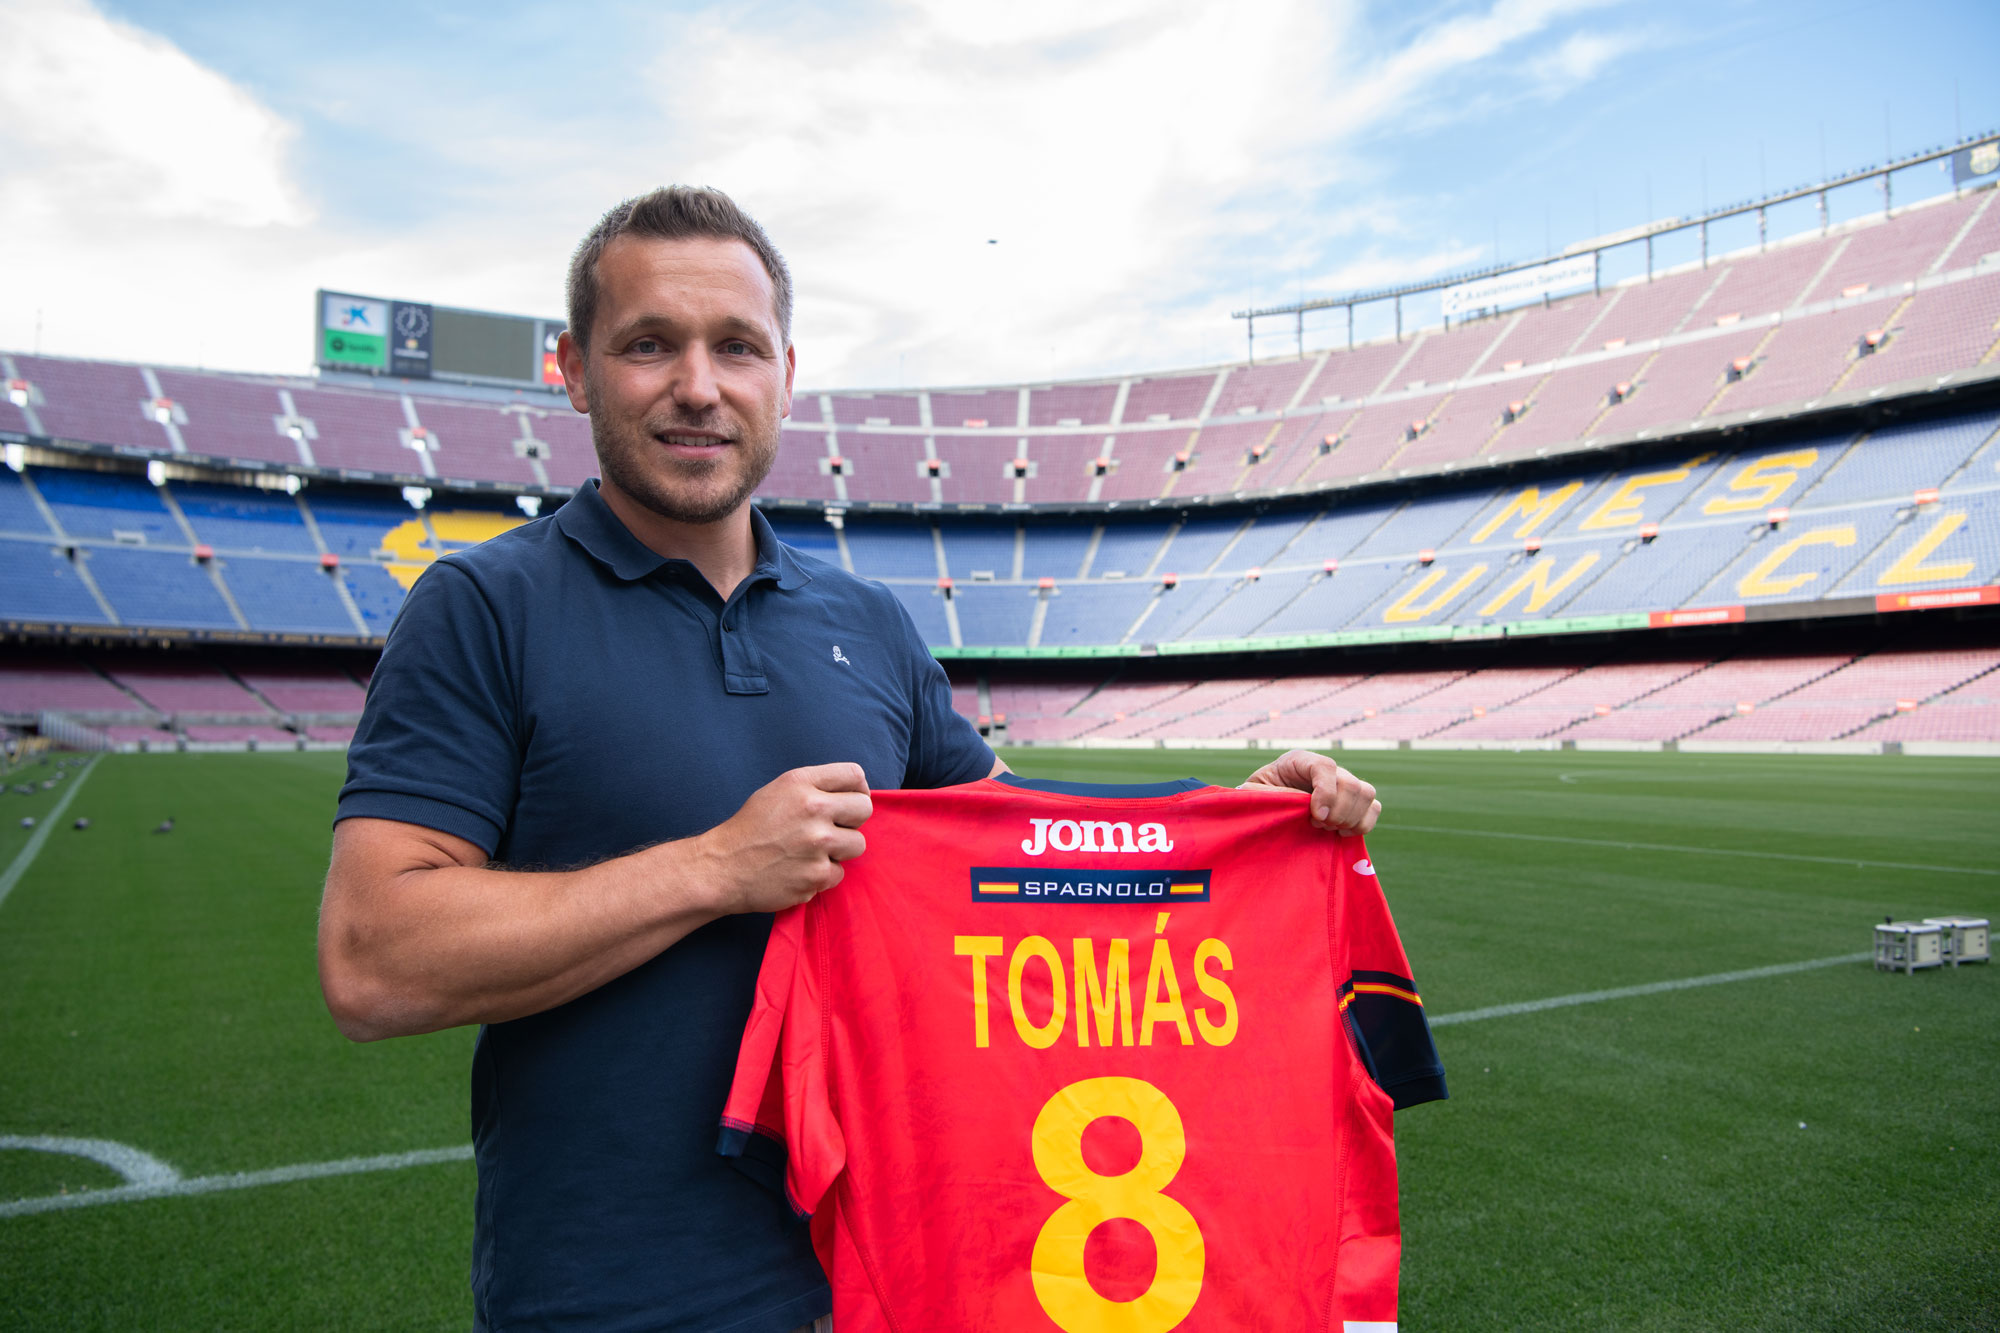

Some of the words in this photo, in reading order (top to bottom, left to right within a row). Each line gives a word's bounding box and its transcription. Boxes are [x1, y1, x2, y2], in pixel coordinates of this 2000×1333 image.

[1469, 447, 1819, 544] MES
[1383, 552, 1601, 623] UN
[1021, 818, 1174, 856] Joma
[954, 912, 1239, 1050] TOMÁS
[1031, 1076, 1206, 1333] 8
